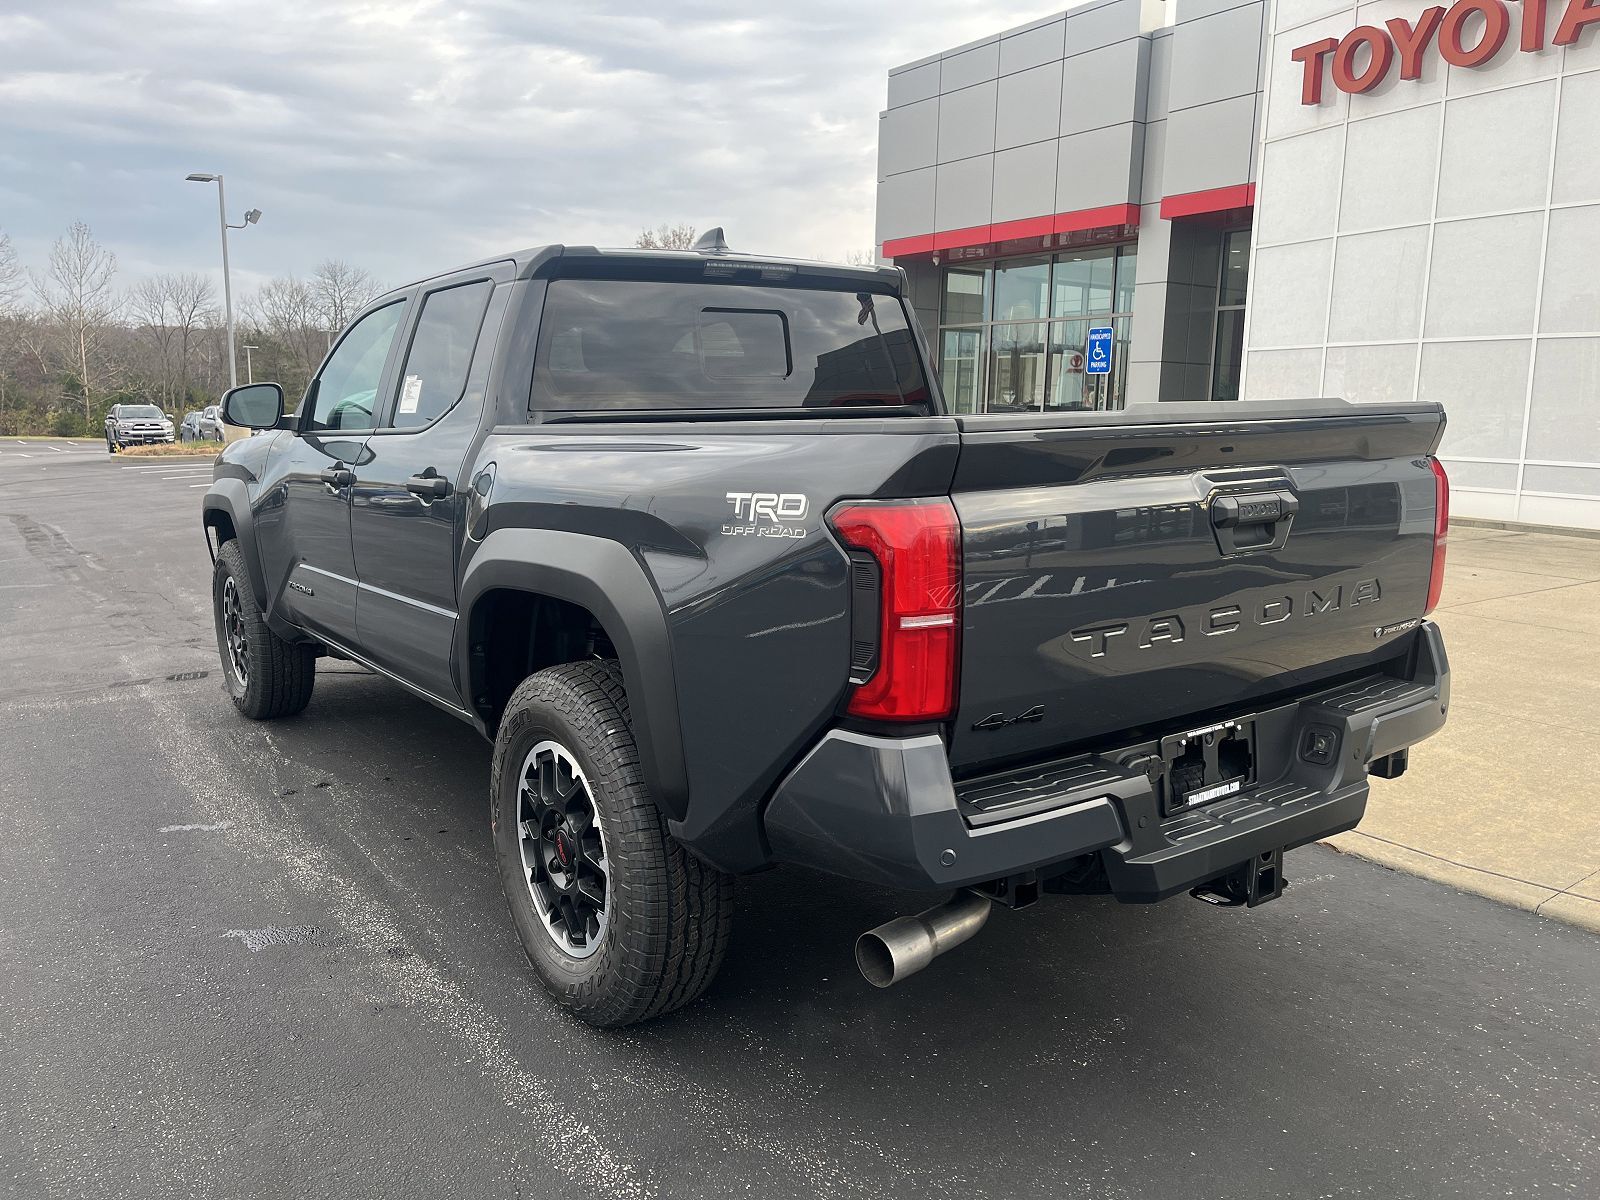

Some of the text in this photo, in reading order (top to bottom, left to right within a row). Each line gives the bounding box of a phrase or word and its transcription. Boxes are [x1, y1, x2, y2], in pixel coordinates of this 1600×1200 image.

[725, 491, 809, 524] TRD
[1240, 502, 1280, 518] TOYOTA
[720, 525, 807, 538] OFF ROAD
[288, 580, 314, 596] TACOMA
[1070, 577, 1382, 657] TACOMA
